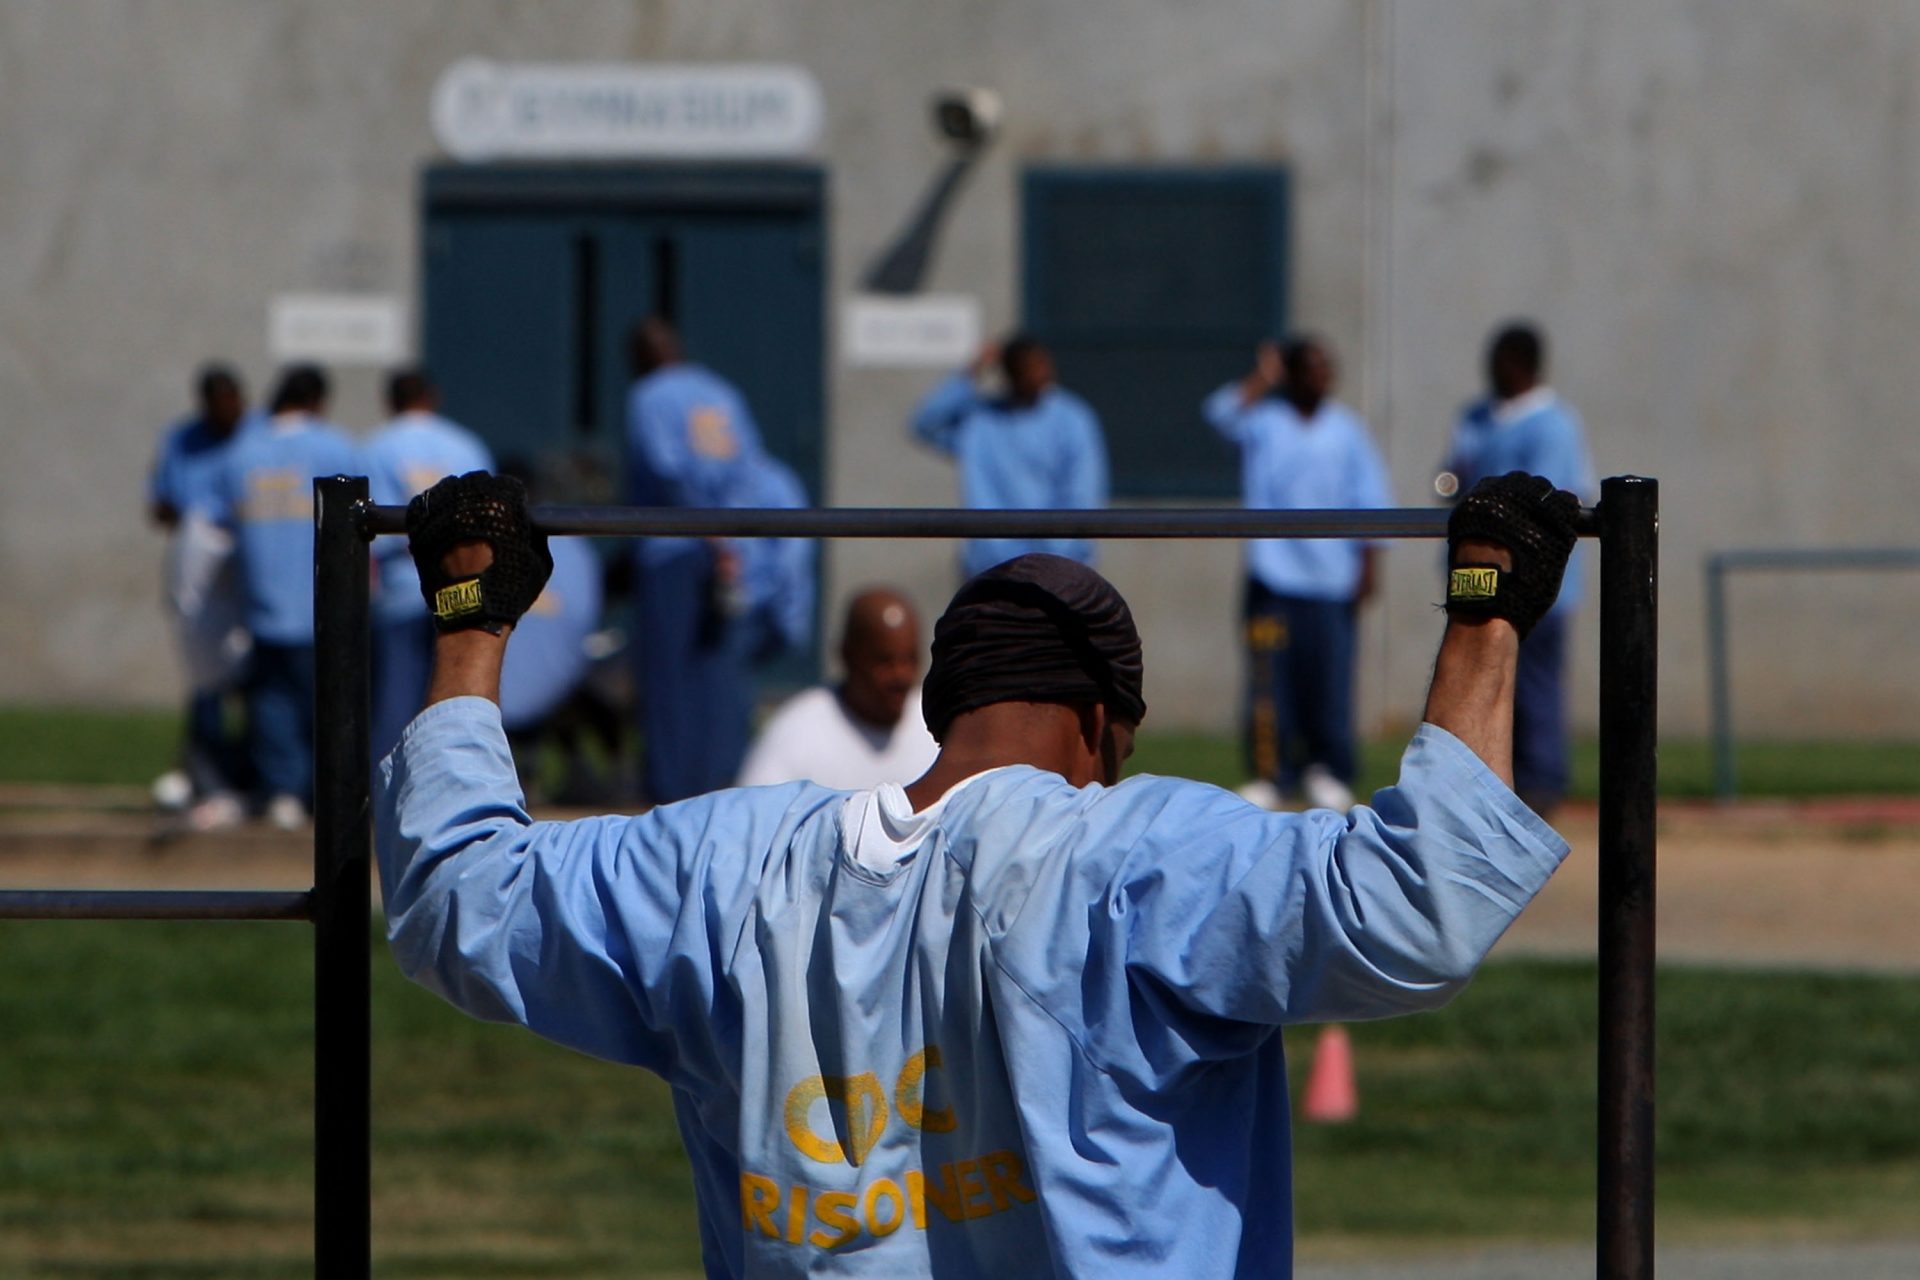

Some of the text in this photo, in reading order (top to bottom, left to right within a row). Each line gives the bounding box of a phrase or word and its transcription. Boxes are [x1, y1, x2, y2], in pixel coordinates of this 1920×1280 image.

[1450, 571, 1495, 594] EVERLAST
[786, 1044, 957, 1167] CDC
[741, 1149, 1037, 1249] RISONER
